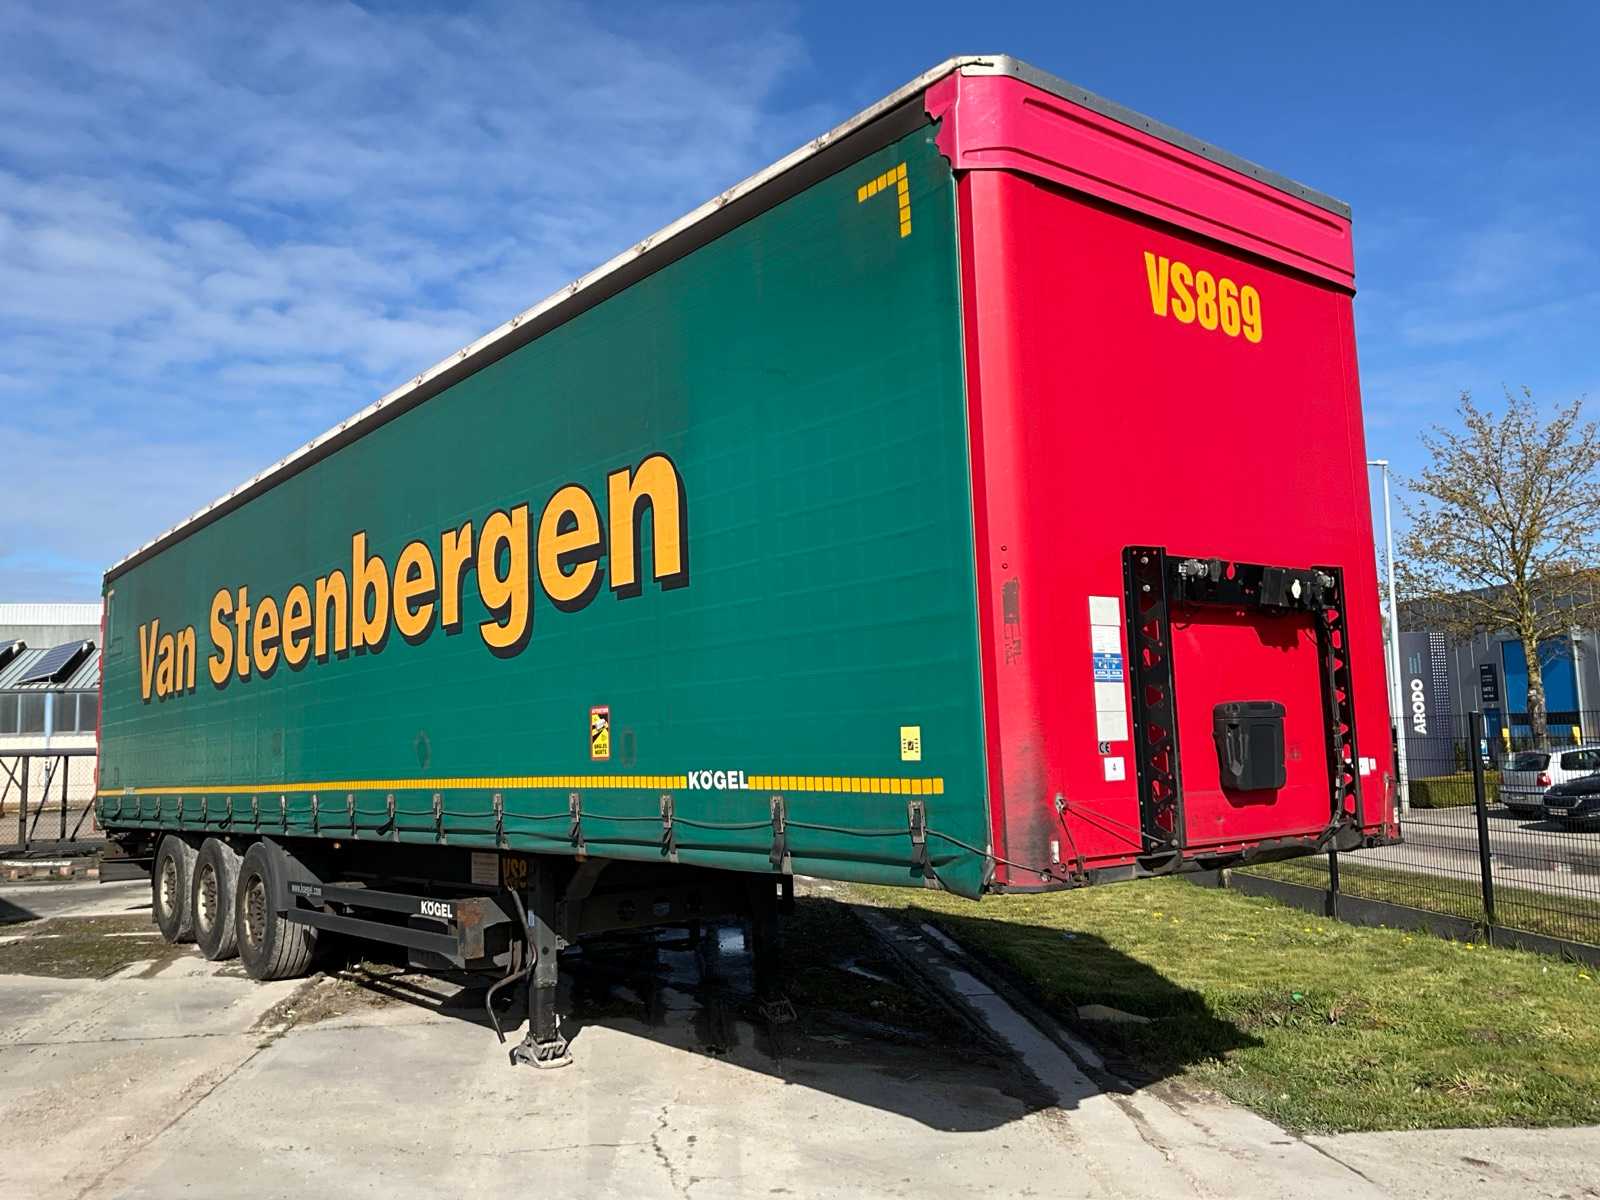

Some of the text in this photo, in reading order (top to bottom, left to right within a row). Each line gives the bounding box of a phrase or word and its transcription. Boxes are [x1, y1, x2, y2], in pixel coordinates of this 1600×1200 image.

[1143, 250, 1263, 344] VS869
[137, 452, 689, 700] Van Steenbergen
[1410, 678, 1427, 735] ARODO
[687, 769, 749, 790] KÖGEL
[420, 900, 453, 918] KÖGEL
